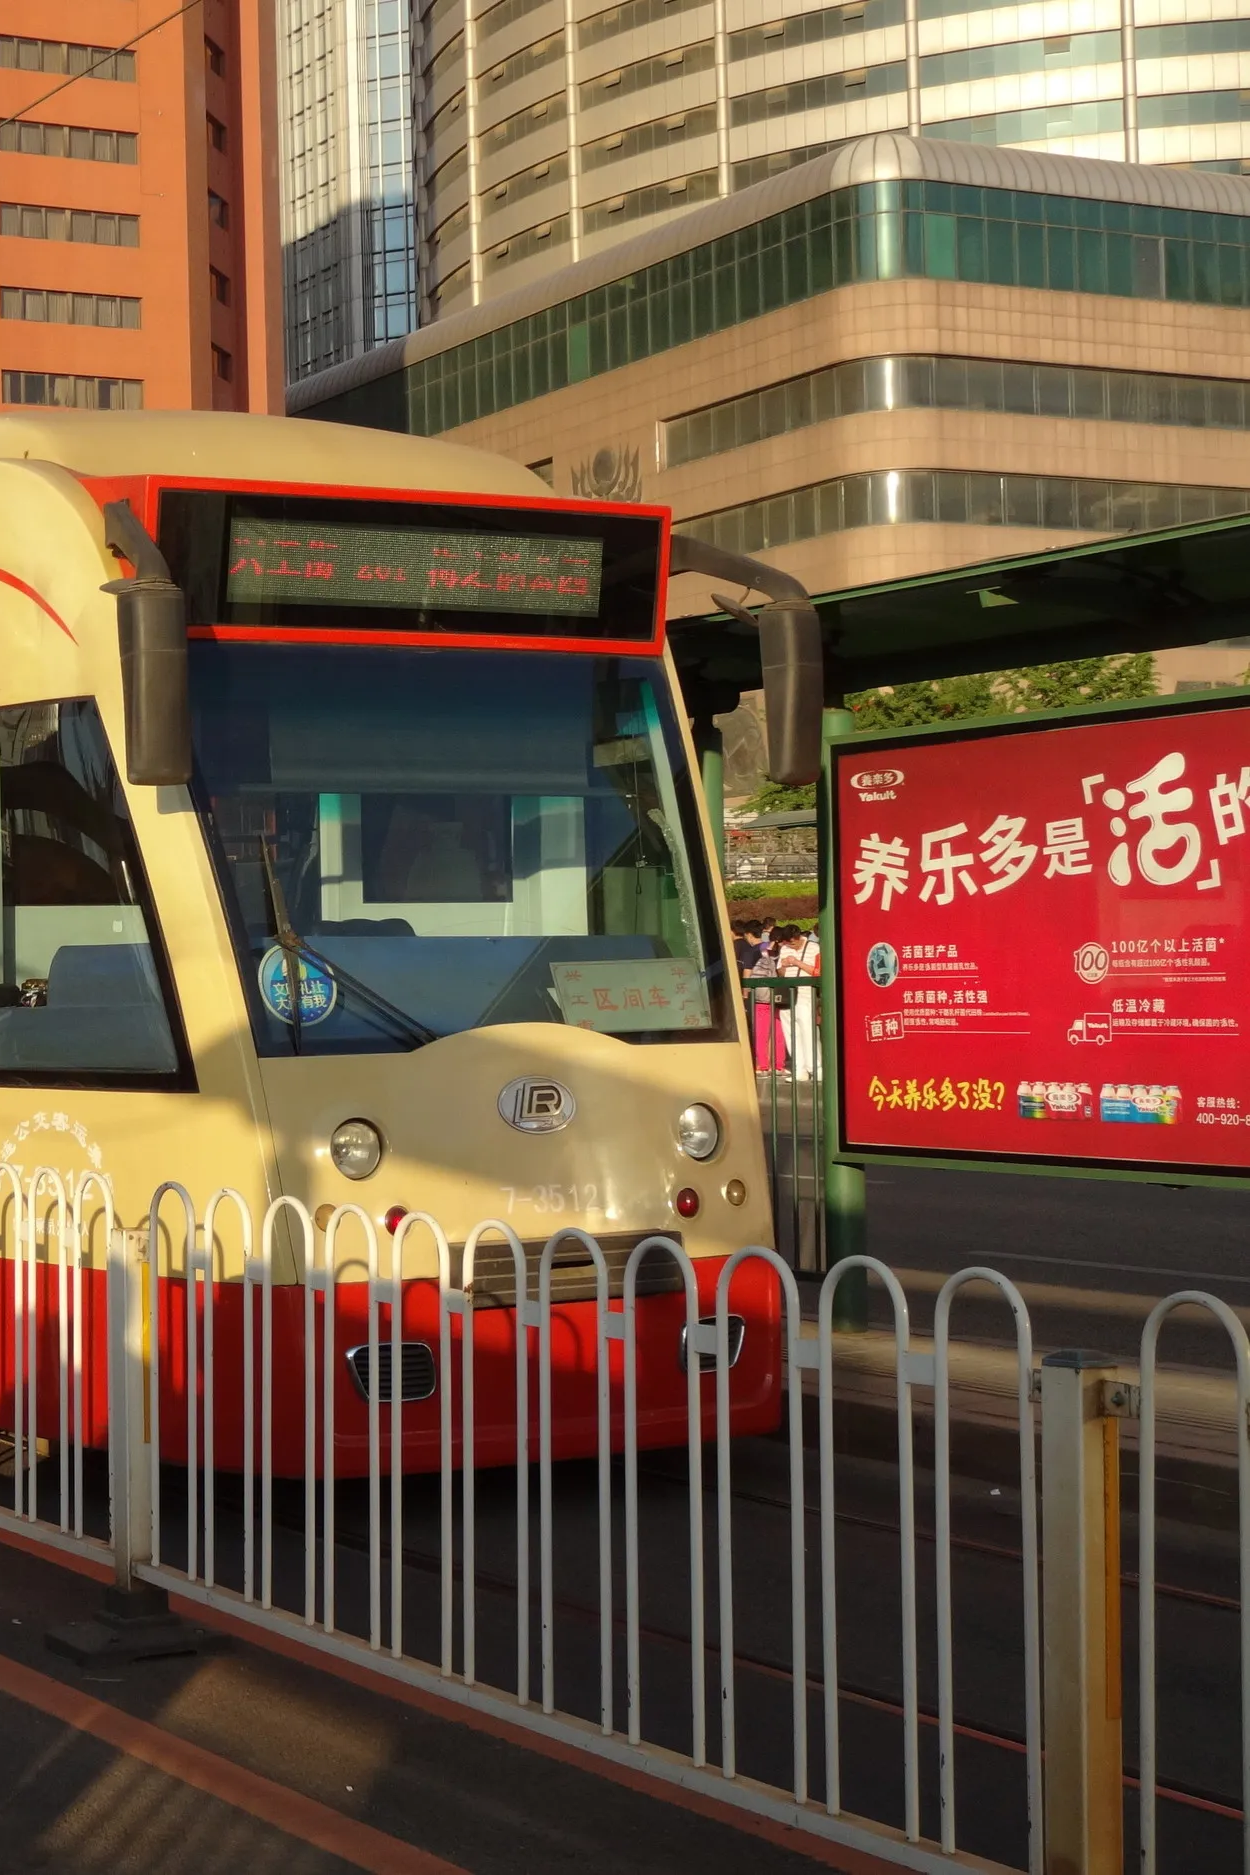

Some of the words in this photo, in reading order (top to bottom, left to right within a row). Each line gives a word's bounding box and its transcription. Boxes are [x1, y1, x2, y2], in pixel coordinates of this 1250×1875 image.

[858, 790, 897, 802] Yakult
[902, 945, 958, 959] 活菌型产品
[1074, 950, 1108, 972] 100
[593, 985, 670, 1012] 区间车
[1112, 998, 1166, 1013] 低温冷藏
[870, 1018, 899, 1038] 菌种
[500, 1183, 599, 1215] 7-3512
